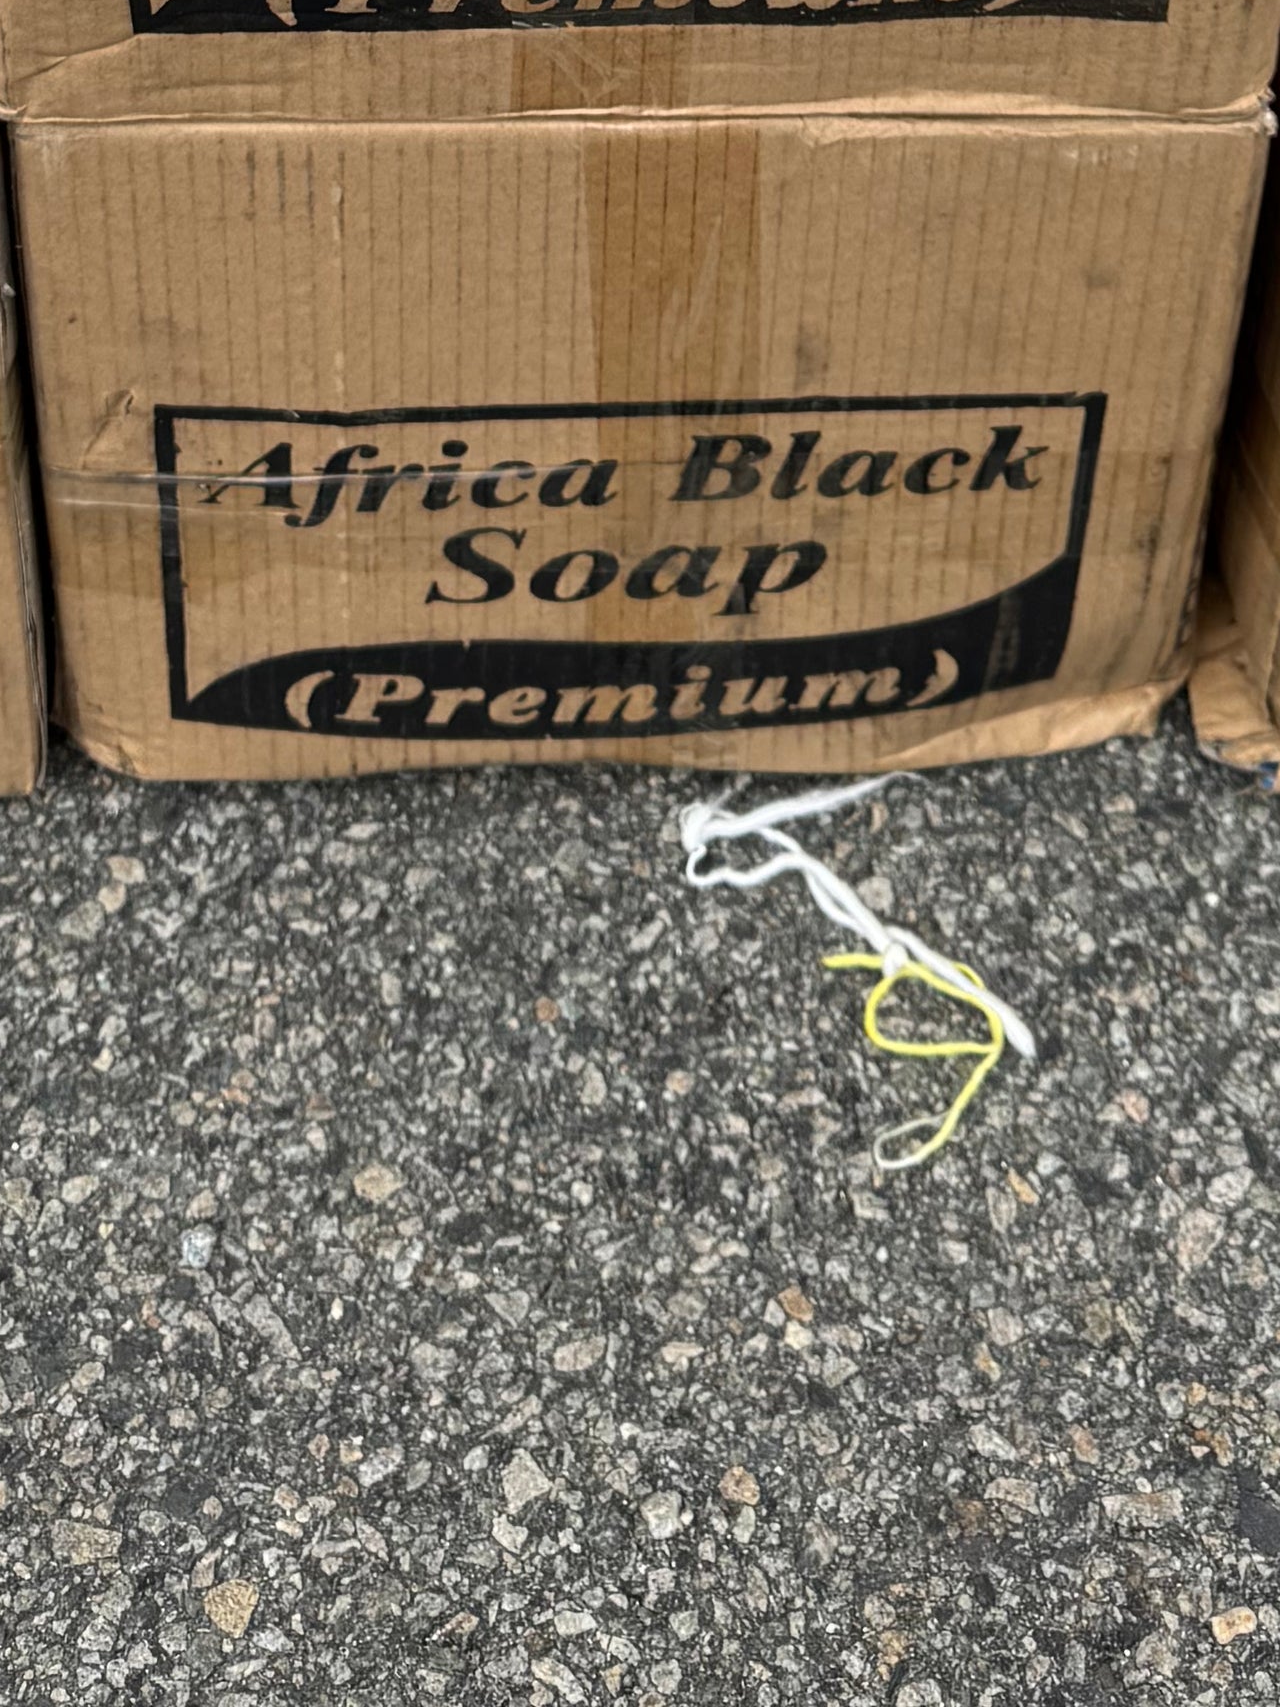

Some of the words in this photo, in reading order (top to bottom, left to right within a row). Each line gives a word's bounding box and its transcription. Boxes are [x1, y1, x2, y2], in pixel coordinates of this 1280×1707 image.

[195, 437, 620, 528] Africa
[668, 423, 1052, 508] Black
[423, 525, 829, 618] Soap
[283, 647, 962, 729] (Premium)
